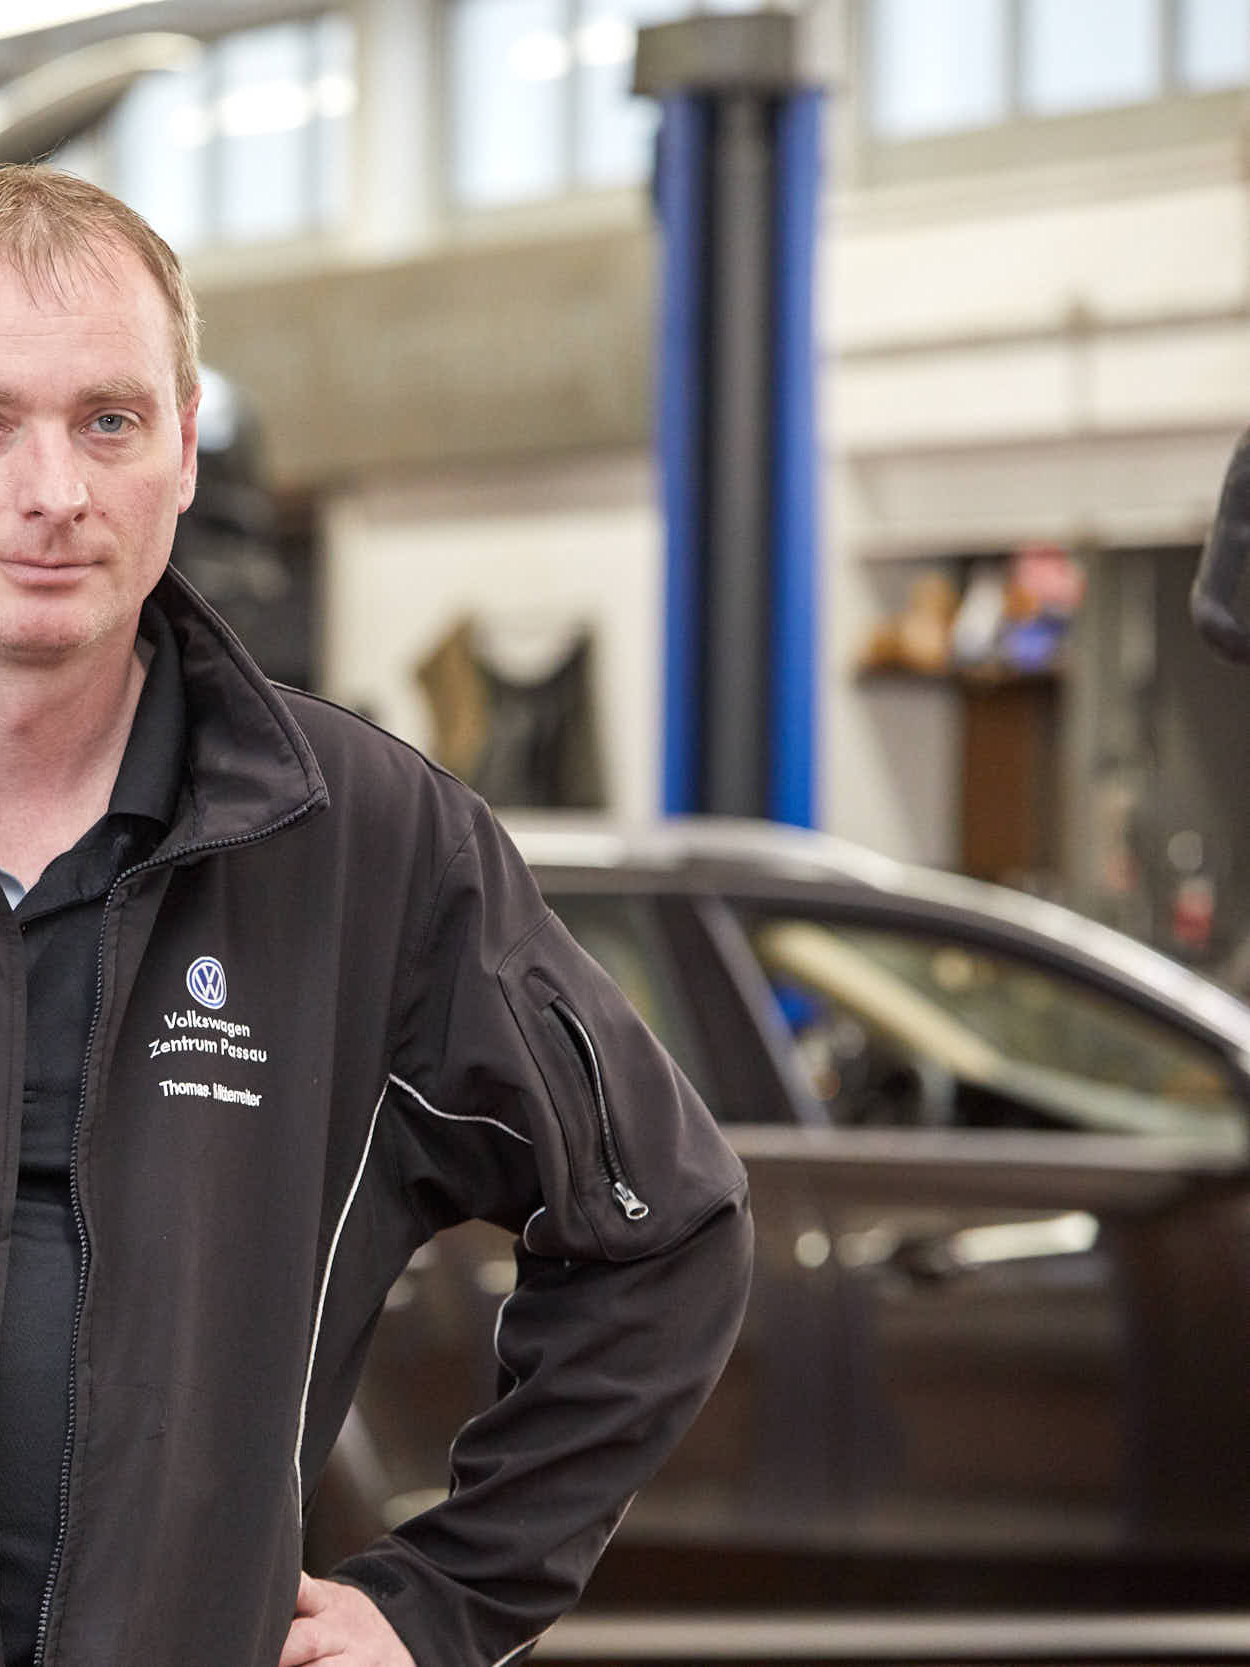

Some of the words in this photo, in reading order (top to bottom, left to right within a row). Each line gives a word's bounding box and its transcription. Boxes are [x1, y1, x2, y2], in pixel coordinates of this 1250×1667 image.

[164, 1010, 250, 1038] Volkswagen
[149, 1035, 217, 1058] Zentrum
[221, 1038, 267, 1062] Passau
